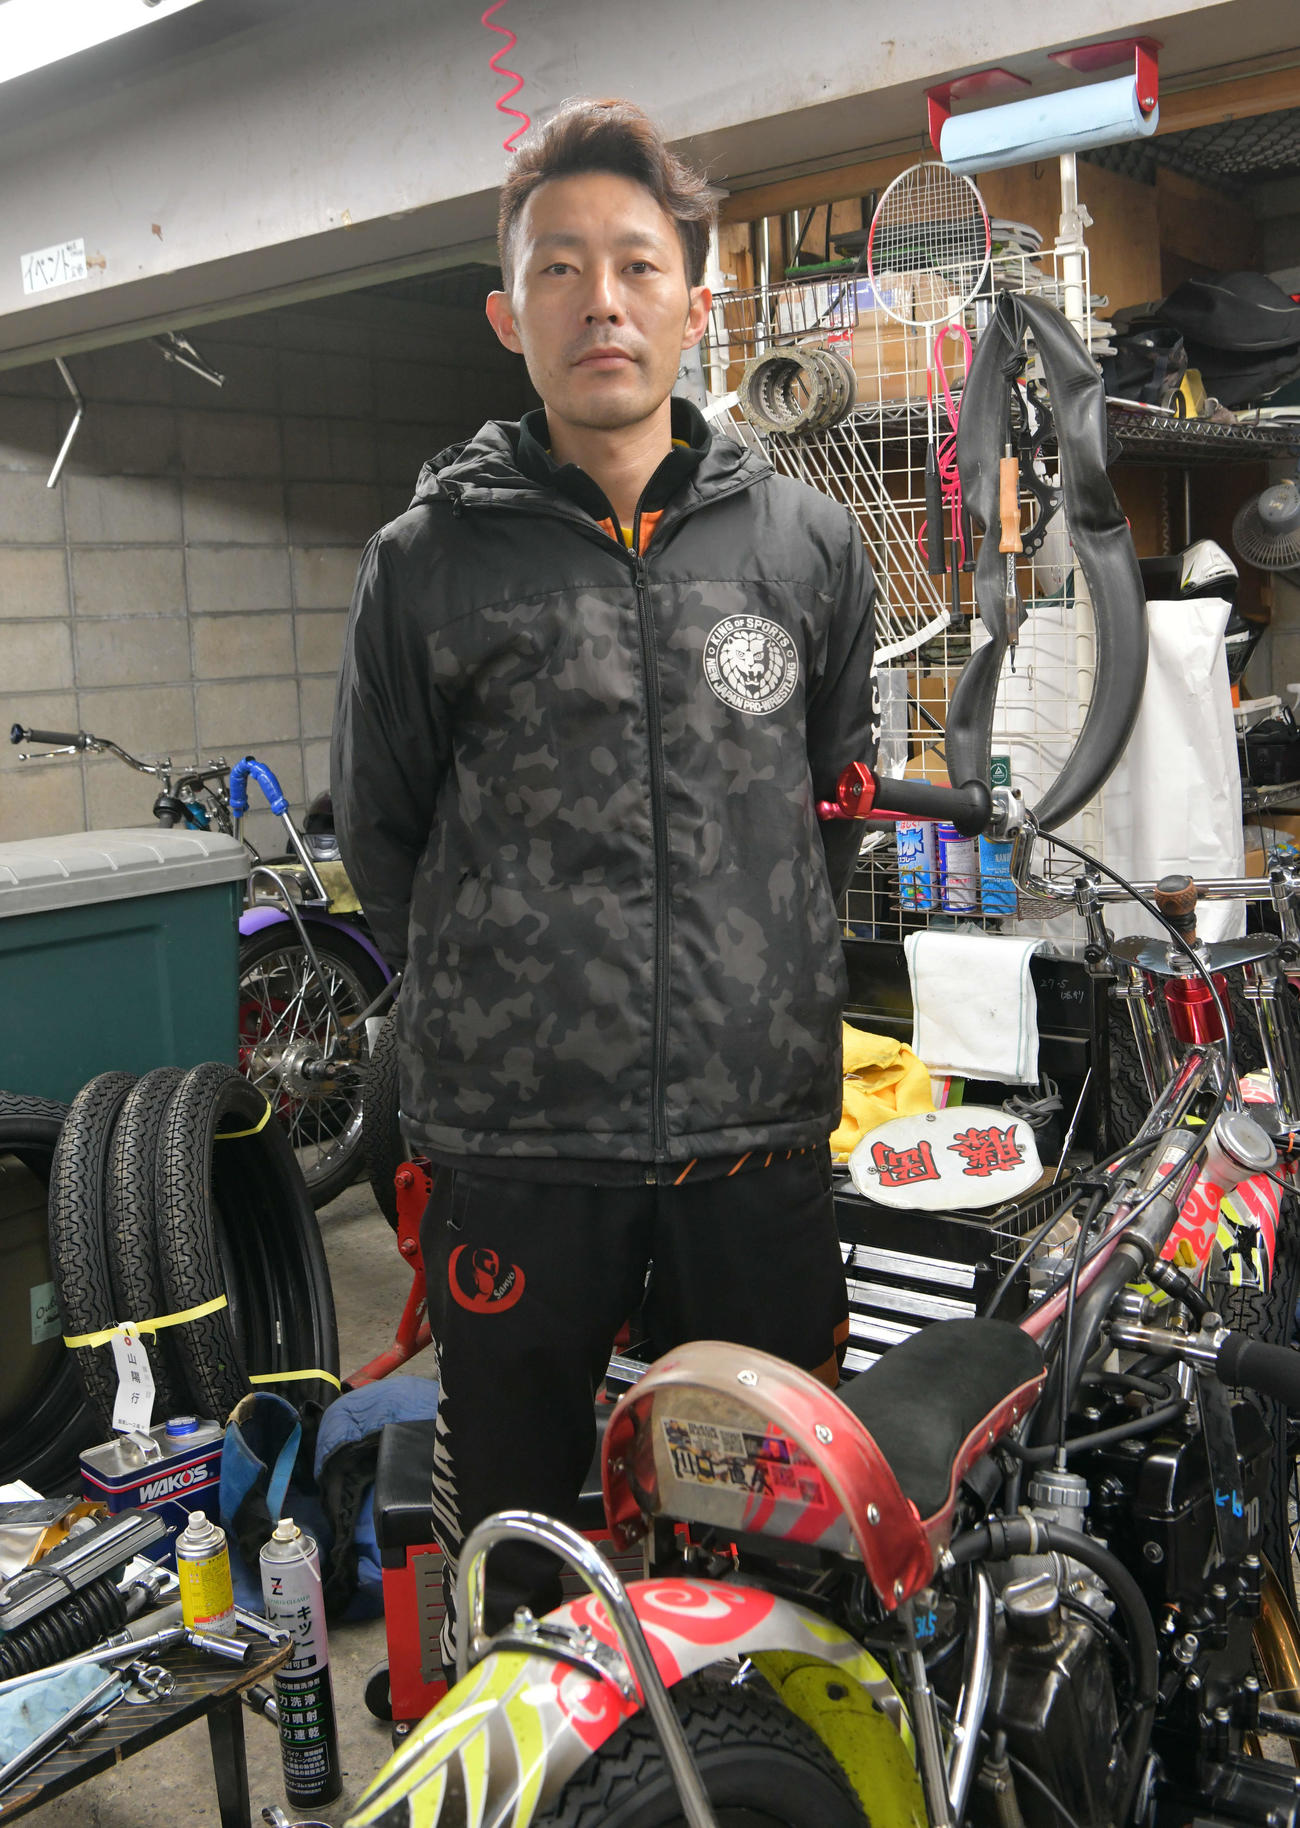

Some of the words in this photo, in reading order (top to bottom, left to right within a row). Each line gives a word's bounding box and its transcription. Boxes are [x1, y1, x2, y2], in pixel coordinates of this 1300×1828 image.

[710, 620, 734, 646] KING
[734, 619, 745, 627] OF
[746, 617, 790, 647] SPORTS
[706, 657, 720, 682] NEW
[713, 681, 743, 708] JAPAN
[743, 662, 796, 712] PRO-WRESTLING
[493, 1271, 515, 1300] Sanyo
